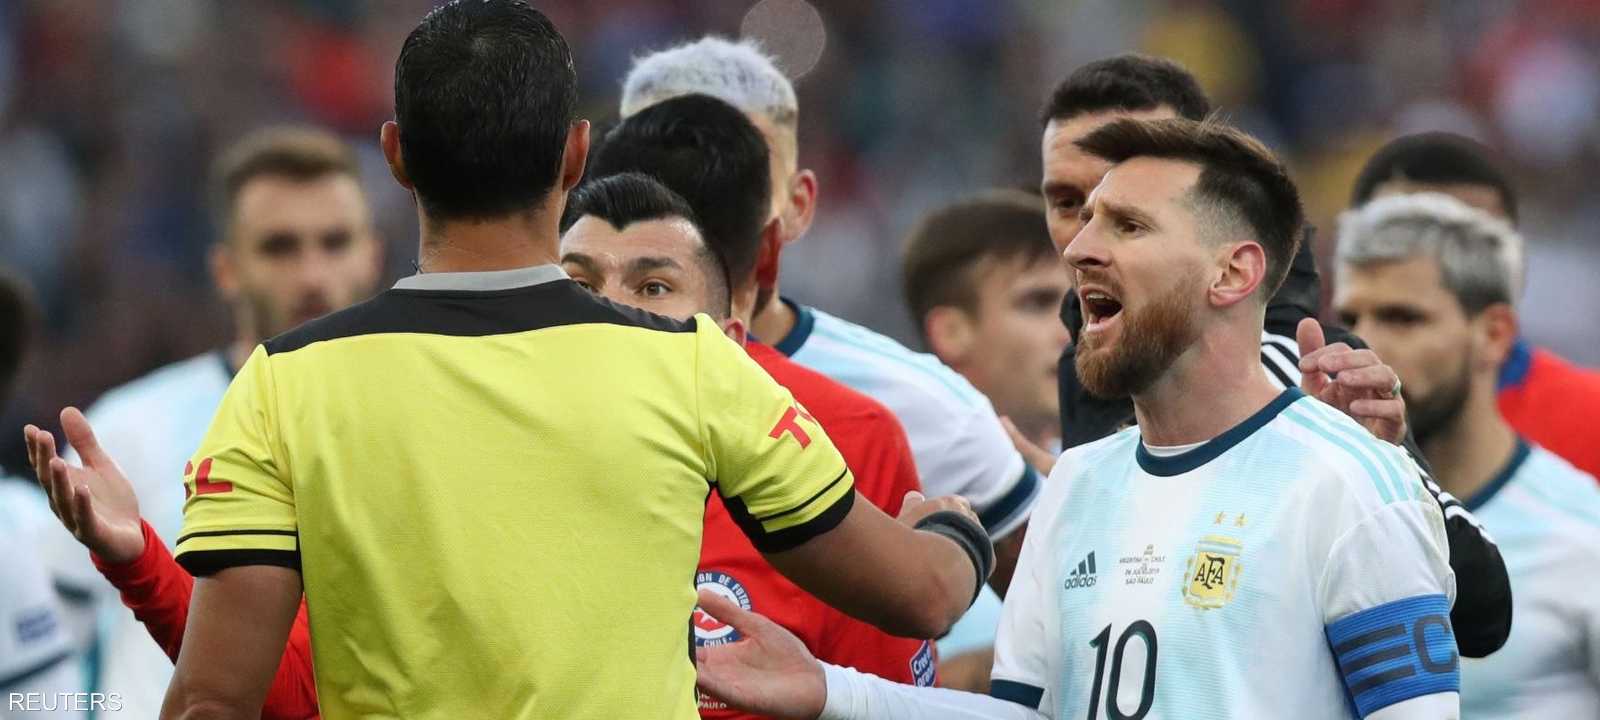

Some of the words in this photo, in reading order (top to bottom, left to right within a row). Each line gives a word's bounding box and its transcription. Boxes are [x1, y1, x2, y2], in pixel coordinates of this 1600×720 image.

[1064, 575, 1097, 590] adidas
[1194, 554, 1225, 590] AFA
[1086, 619, 1158, 720] 10
